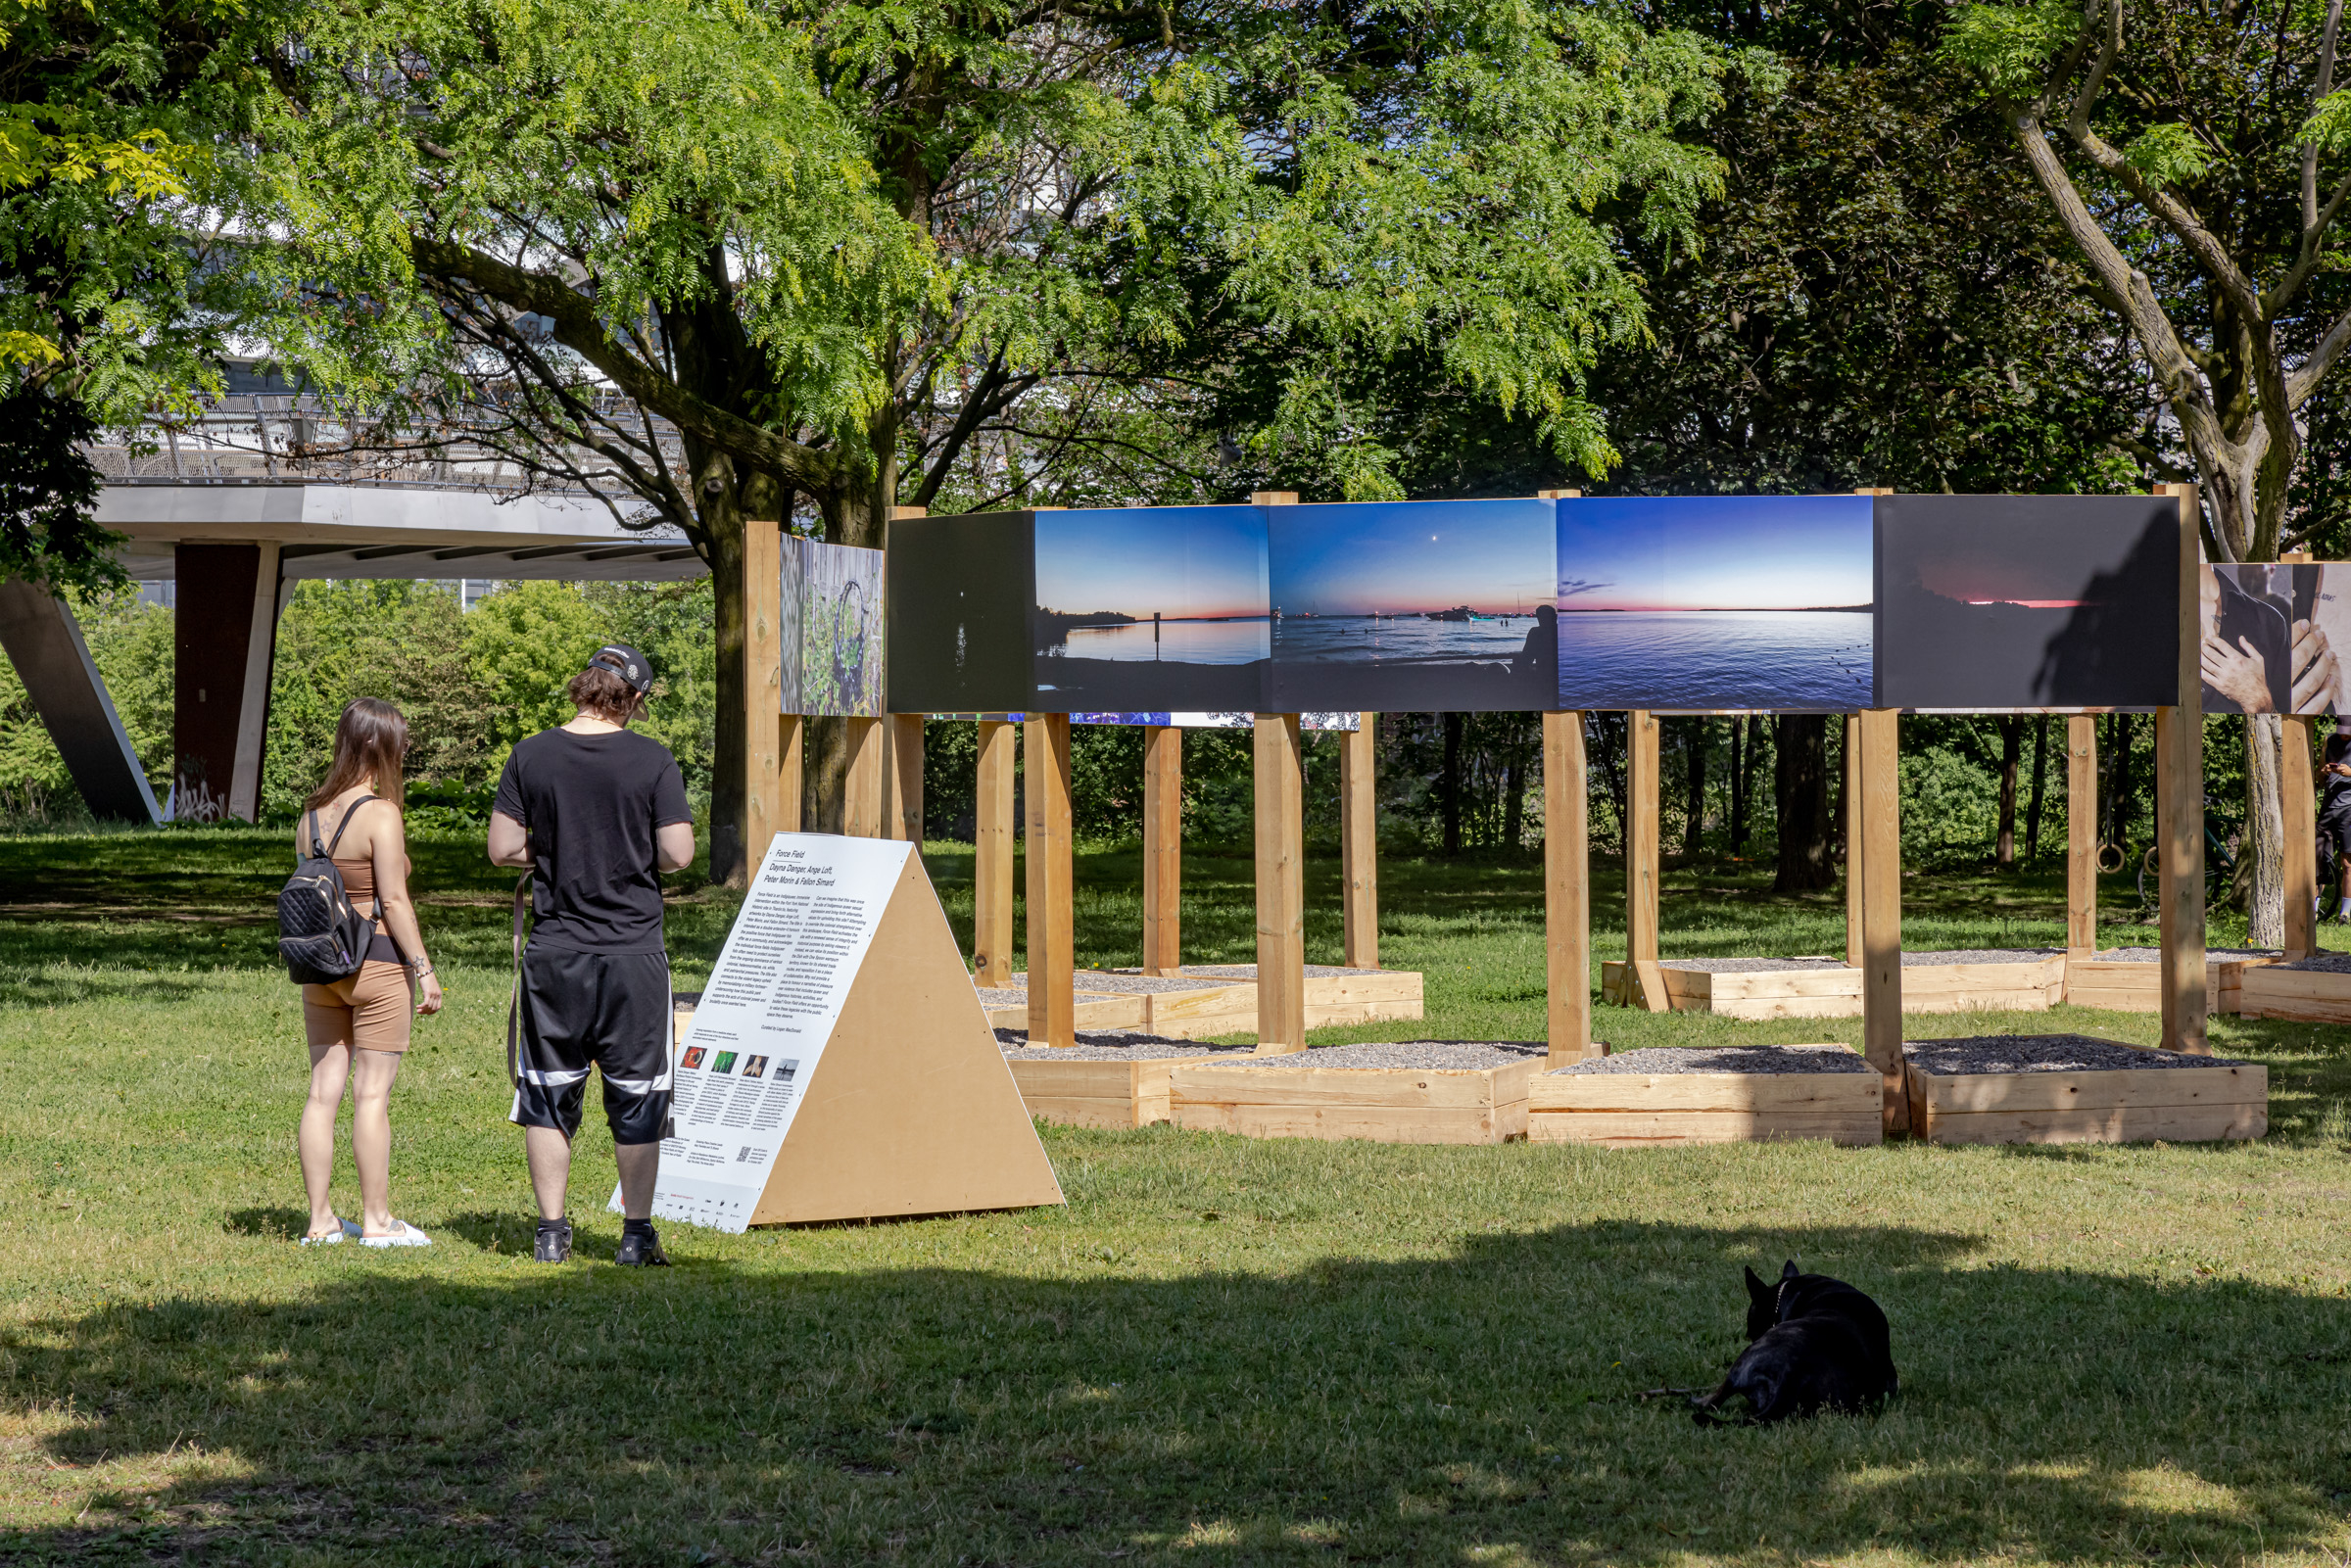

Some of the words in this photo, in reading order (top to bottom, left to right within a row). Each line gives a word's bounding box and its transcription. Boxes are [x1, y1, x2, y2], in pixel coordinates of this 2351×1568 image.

[769, 863, 786, 872] Dayna
[787, 865, 806, 873] Danger,
[807, 866, 821, 874] Ange
